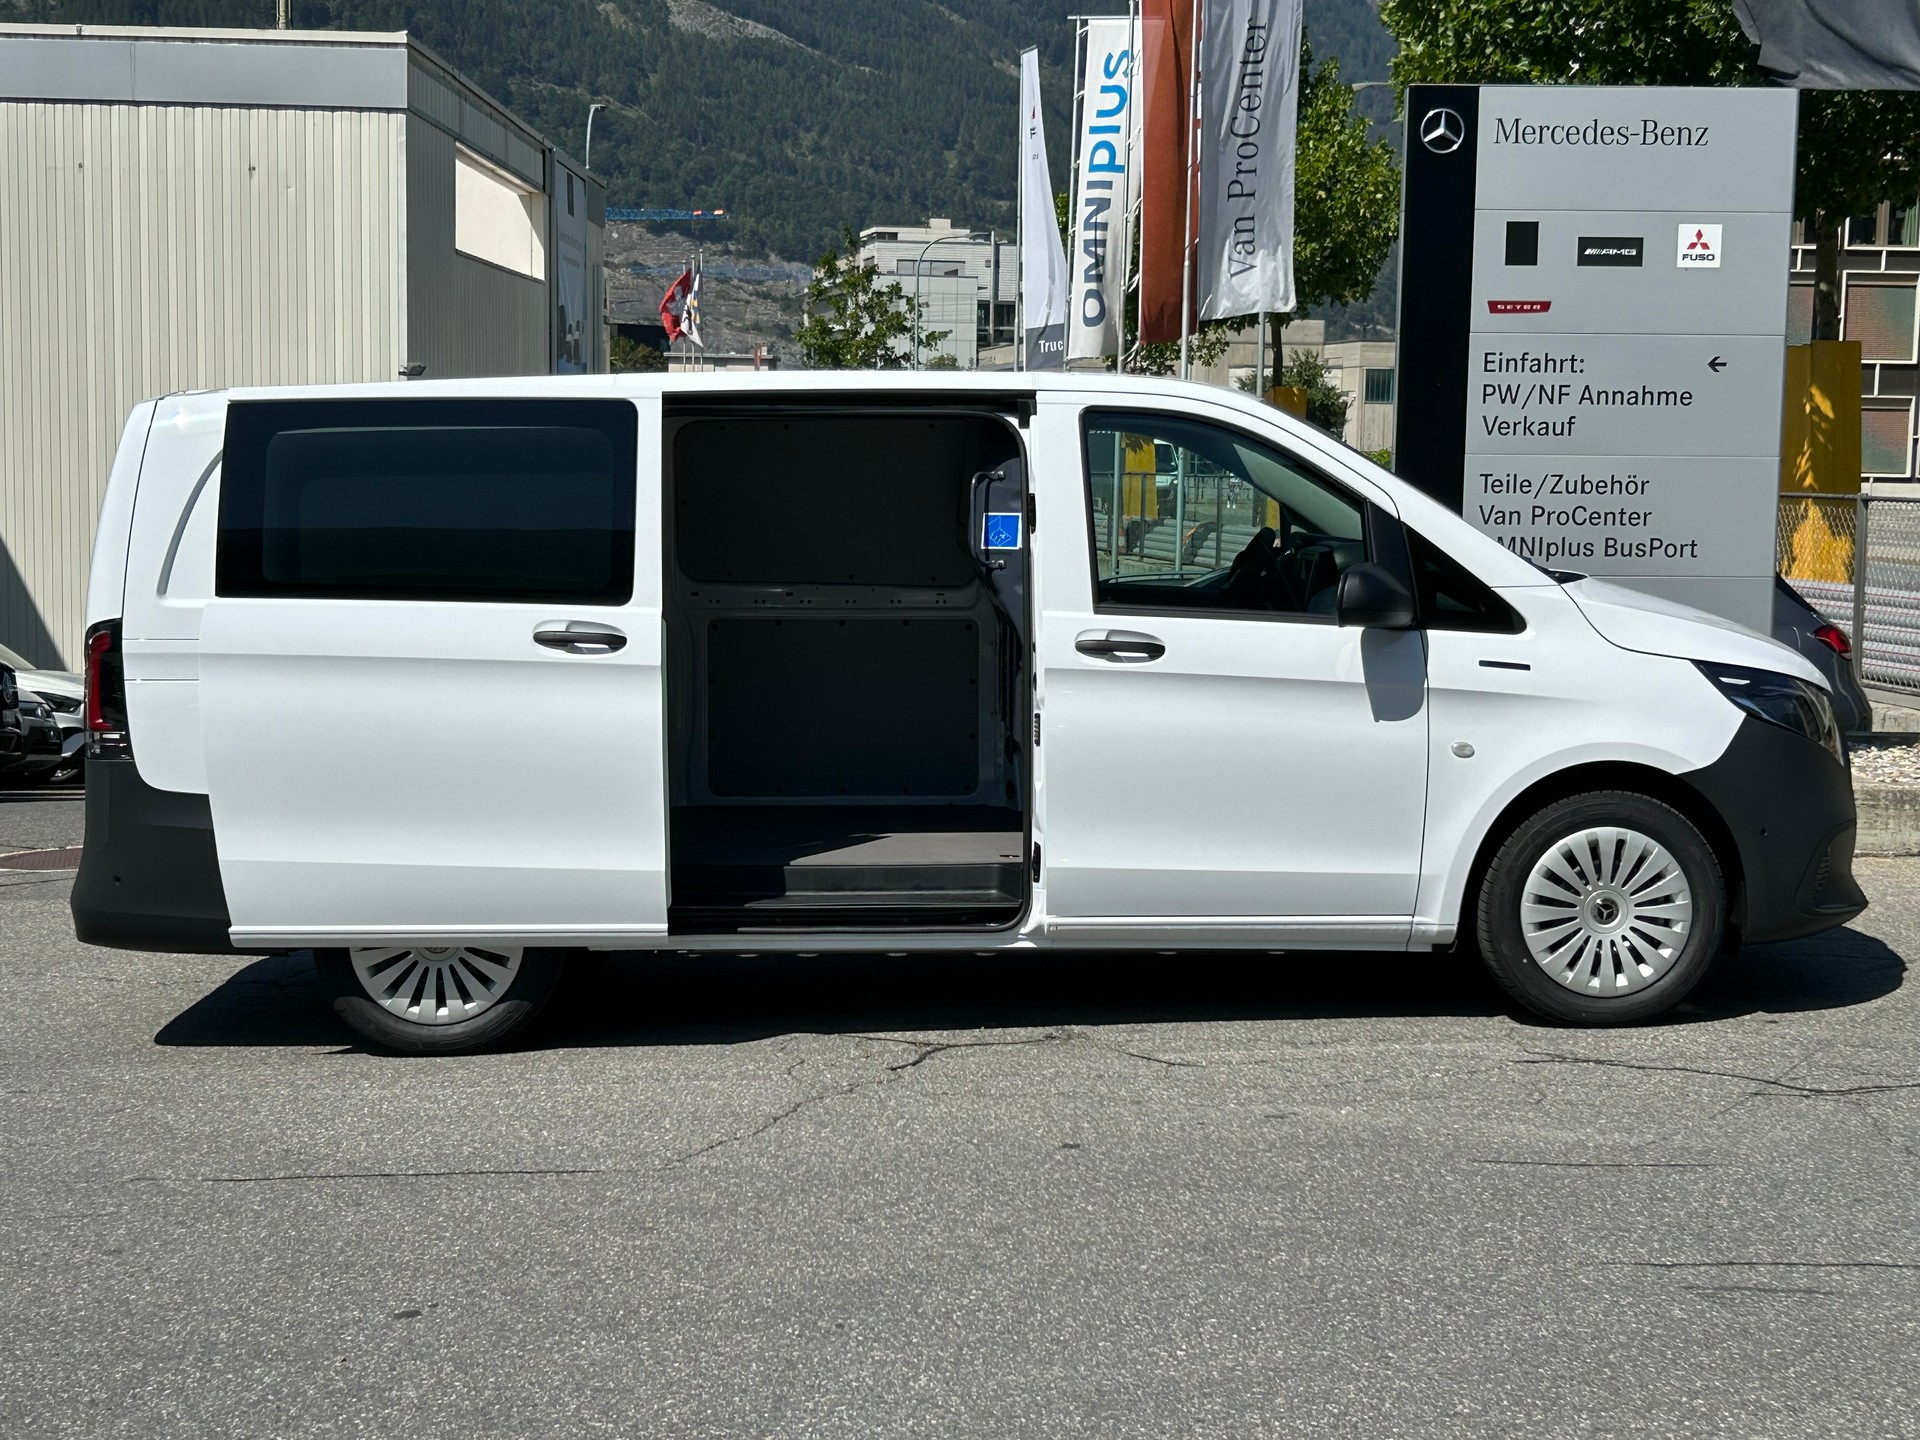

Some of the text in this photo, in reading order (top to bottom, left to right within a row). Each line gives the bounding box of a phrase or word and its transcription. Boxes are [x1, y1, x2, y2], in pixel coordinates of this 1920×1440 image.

[1493, 117, 1709, 147] Mercedes-Benz
[1227, 17, 1267, 281] Van ProCenter
[1681, 253, 1716, 262] FUSO
[1038, 340, 1064, 353] Truc
[1483, 352, 1585, 374] Einfahrt:
[1482, 384, 1693, 409] PW/NF Annahme
[1482, 415, 1577, 437] Verkauf
[1479, 473, 1650, 500] Teile/Zubehör
[1479, 505, 1653, 527] Van ProCenter
[1497, 536, 1698, 562] MNIplus BusPort
